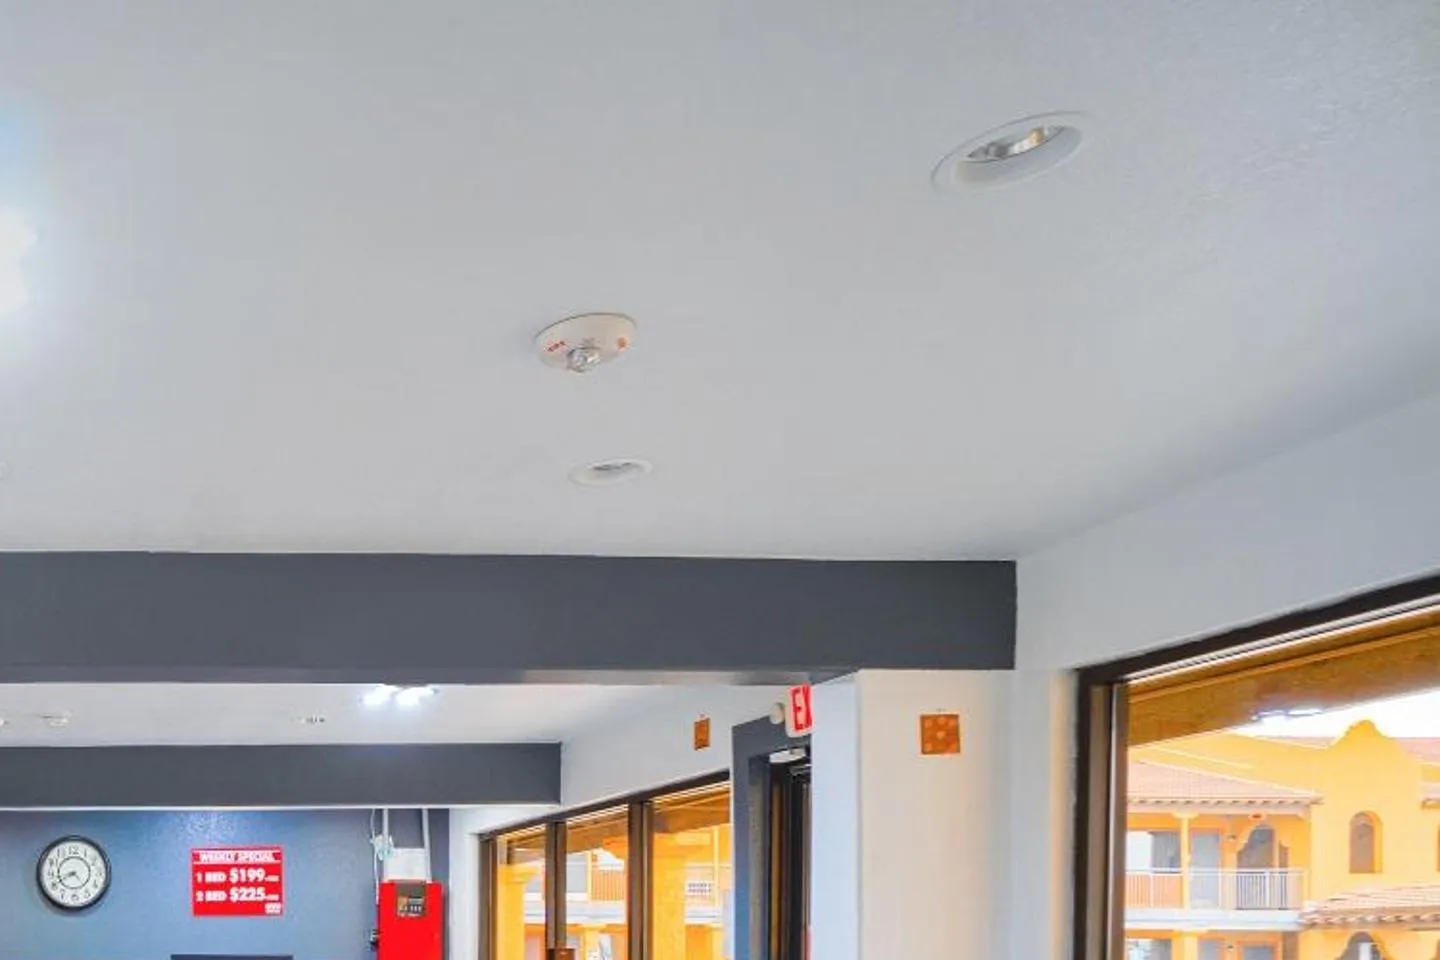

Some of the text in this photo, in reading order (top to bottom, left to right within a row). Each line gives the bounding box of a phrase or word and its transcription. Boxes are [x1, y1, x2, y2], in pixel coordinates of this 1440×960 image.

[237, 851, 276, 862] SPECIAL
[195, 871, 203, 883] 1
[205, 871, 227, 883] BED
[195, 890, 204, 902] 2
[205, 890, 228, 902] BED
